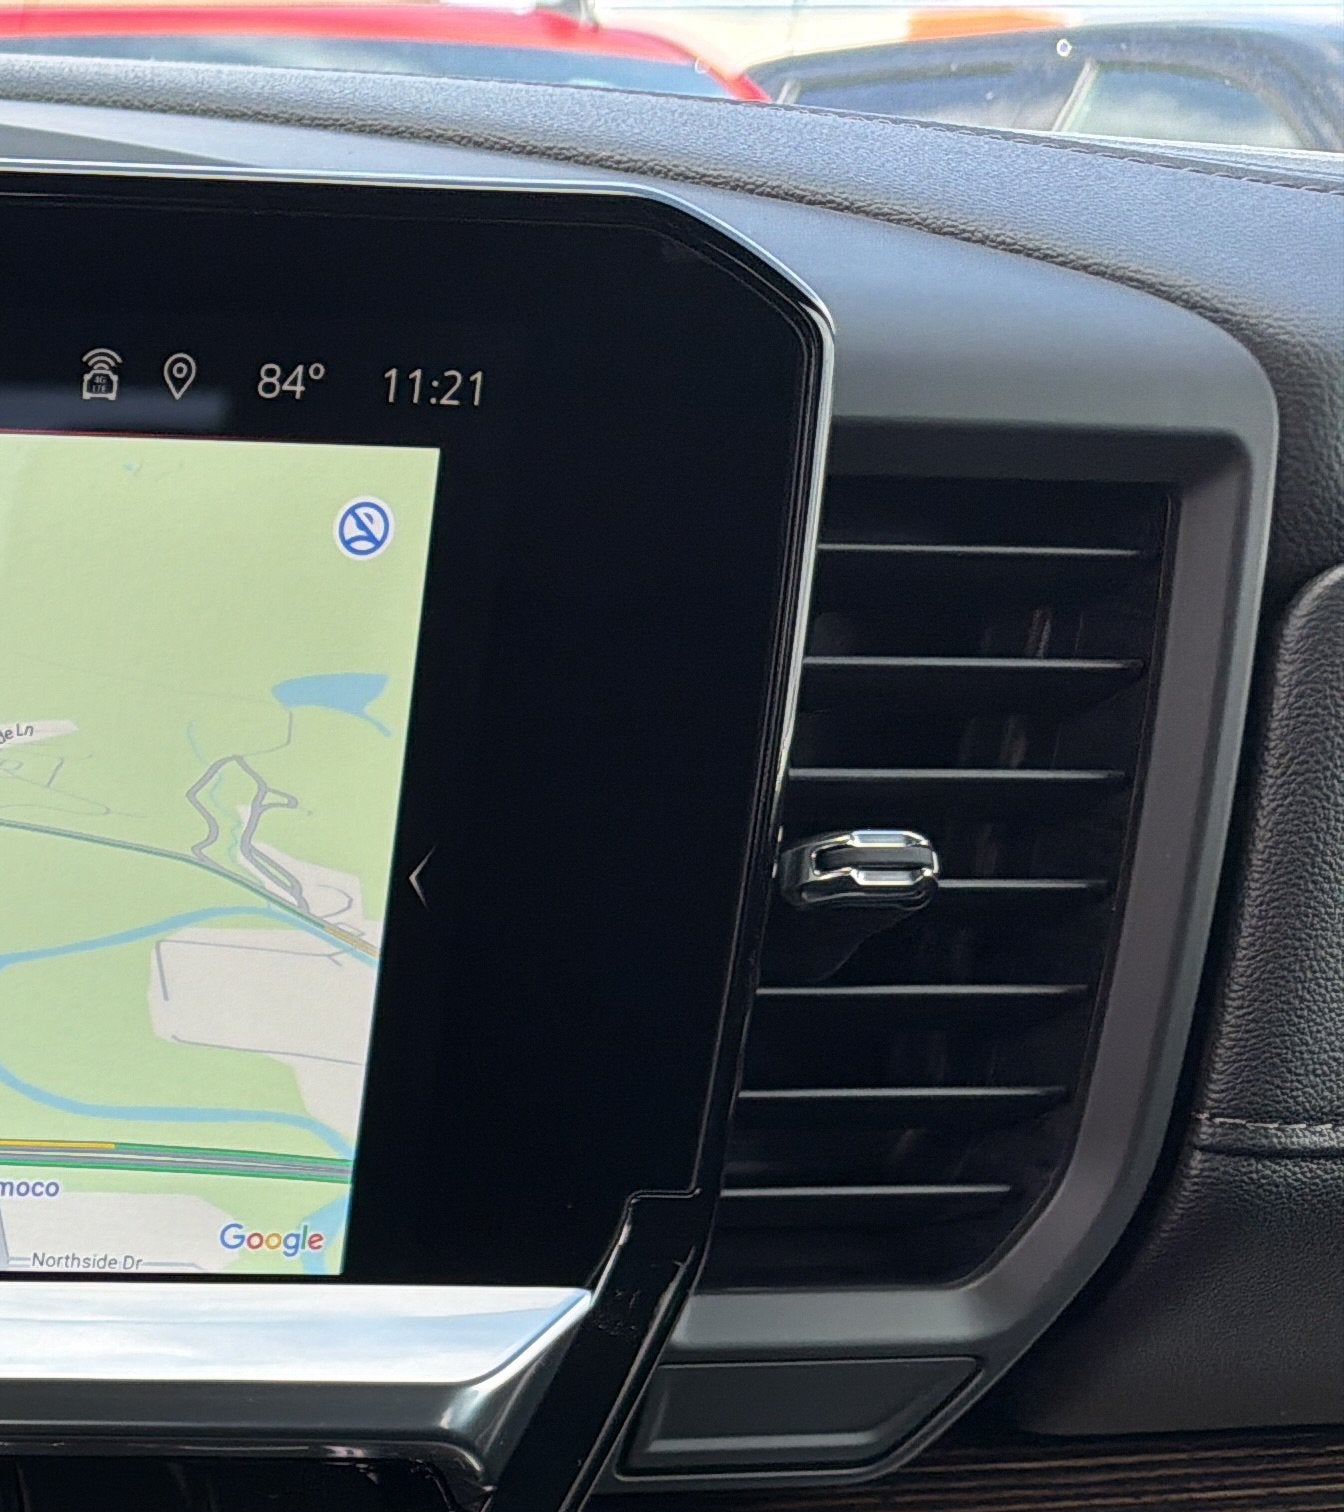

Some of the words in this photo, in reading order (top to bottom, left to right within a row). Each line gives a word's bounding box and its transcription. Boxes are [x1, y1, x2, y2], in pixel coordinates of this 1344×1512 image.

[383, 368, 484, 407] 11:21
[14, 722, 36, 739] Ln
[220, 1223, 324, 1257] Google
[31, 1252, 118, 1270] Northside
[122, 1255, 144, 1271] Dr
